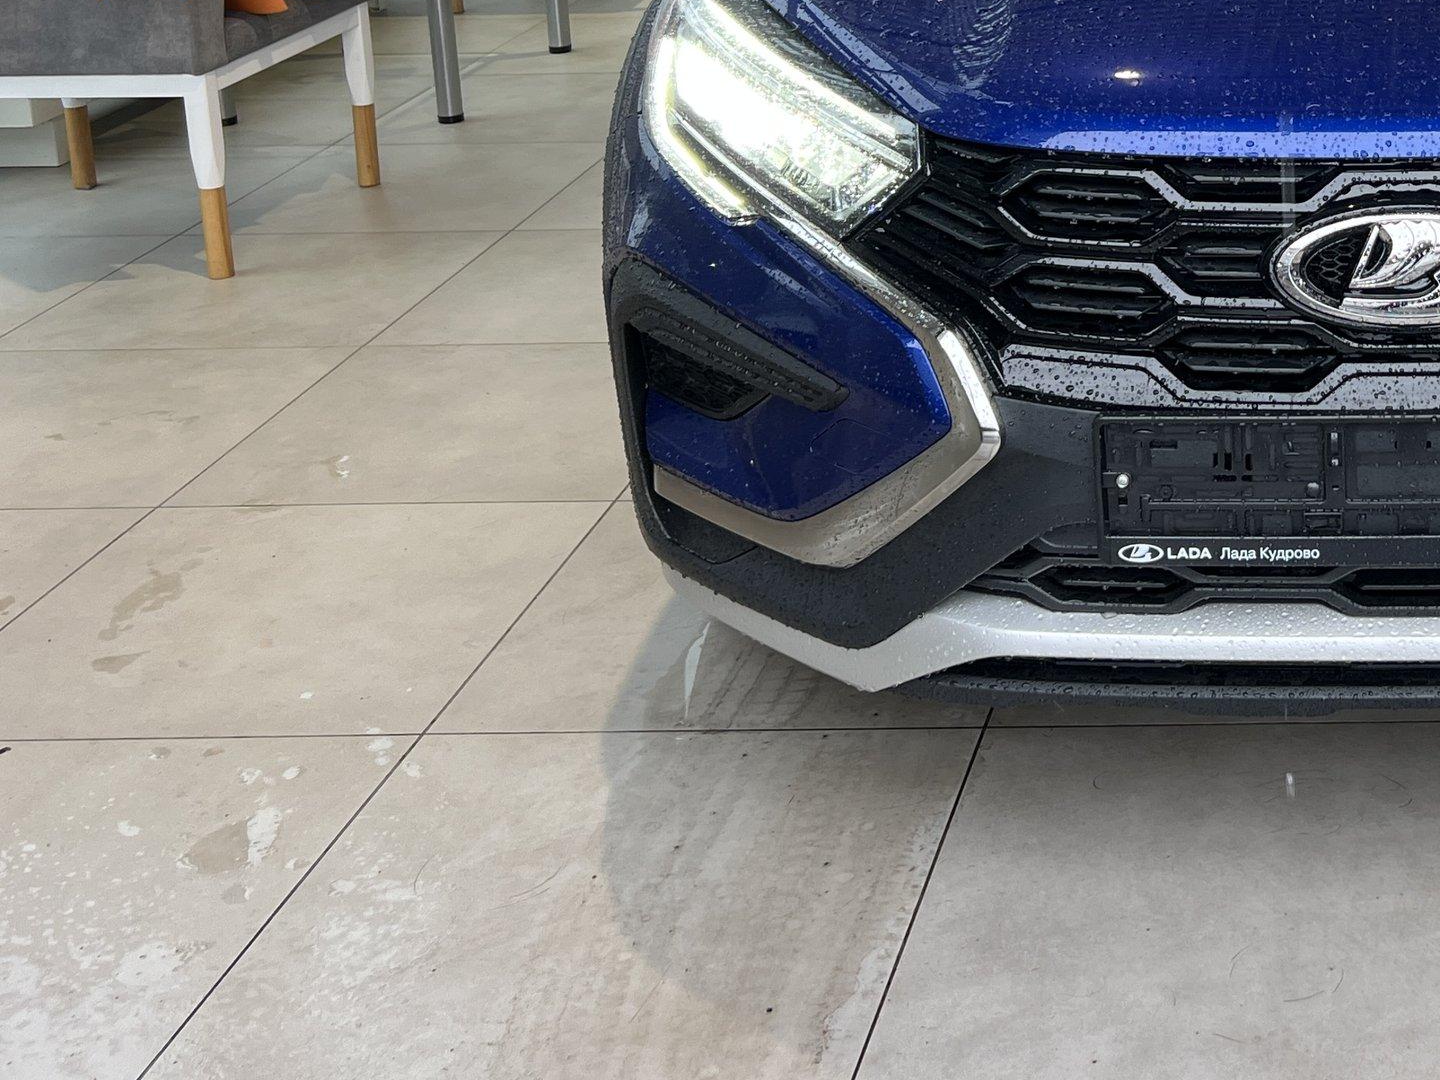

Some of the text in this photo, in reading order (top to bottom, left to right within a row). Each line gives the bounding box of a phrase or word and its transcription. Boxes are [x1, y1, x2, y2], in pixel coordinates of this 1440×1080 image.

[1166, 546, 1212, 559] LADA
[1219, 546, 1321, 562] Лада Кудрово
